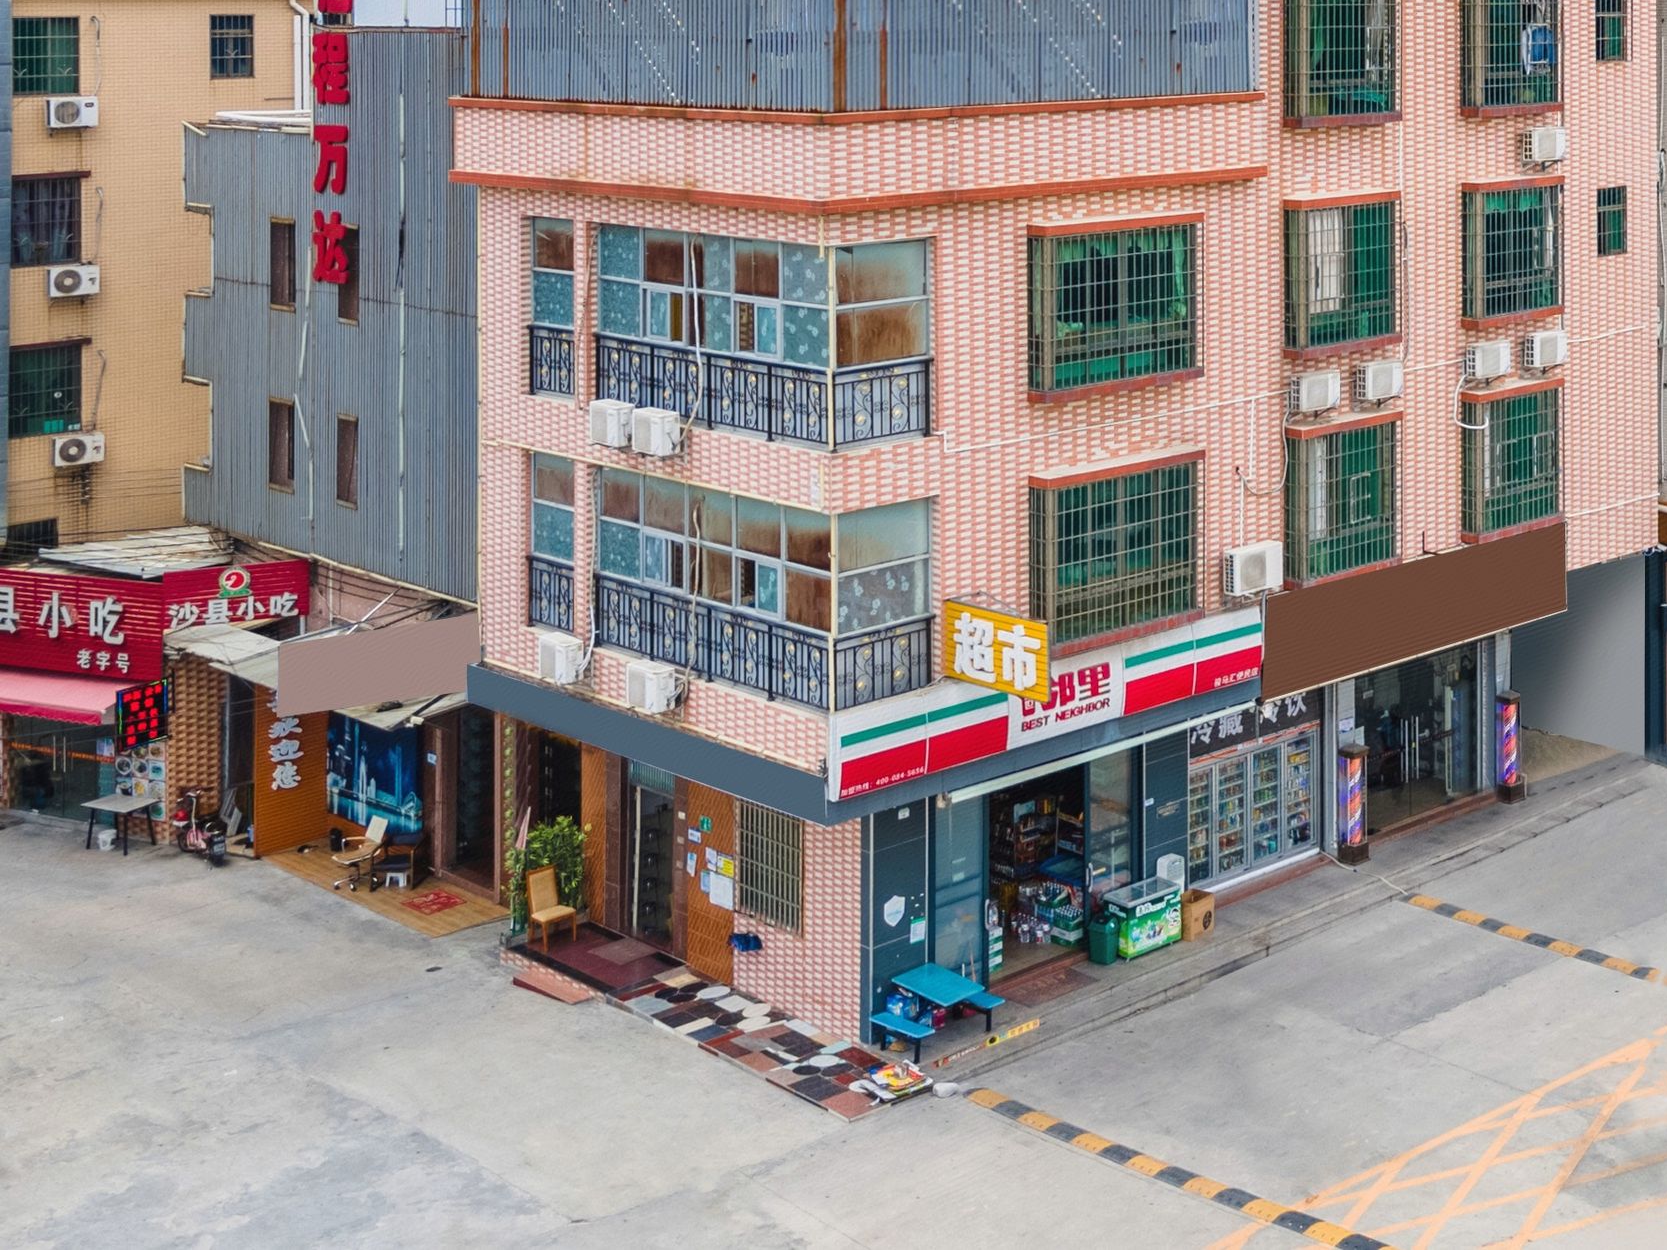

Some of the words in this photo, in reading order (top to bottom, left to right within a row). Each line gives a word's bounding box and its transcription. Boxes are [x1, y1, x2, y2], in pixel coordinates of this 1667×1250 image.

[168, 592, 299, 630] 沙县小吃
[76, 648, 131, 674] 老字号
[953, 612, 1041, 691] 超市
[1021, 661, 1111, 717] 邻里
[1021, 715, 1050, 732] BEST
[1055, 697, 1111, 723] NEIGHBOR
[267, 688, 304, 790] 欢迎您
